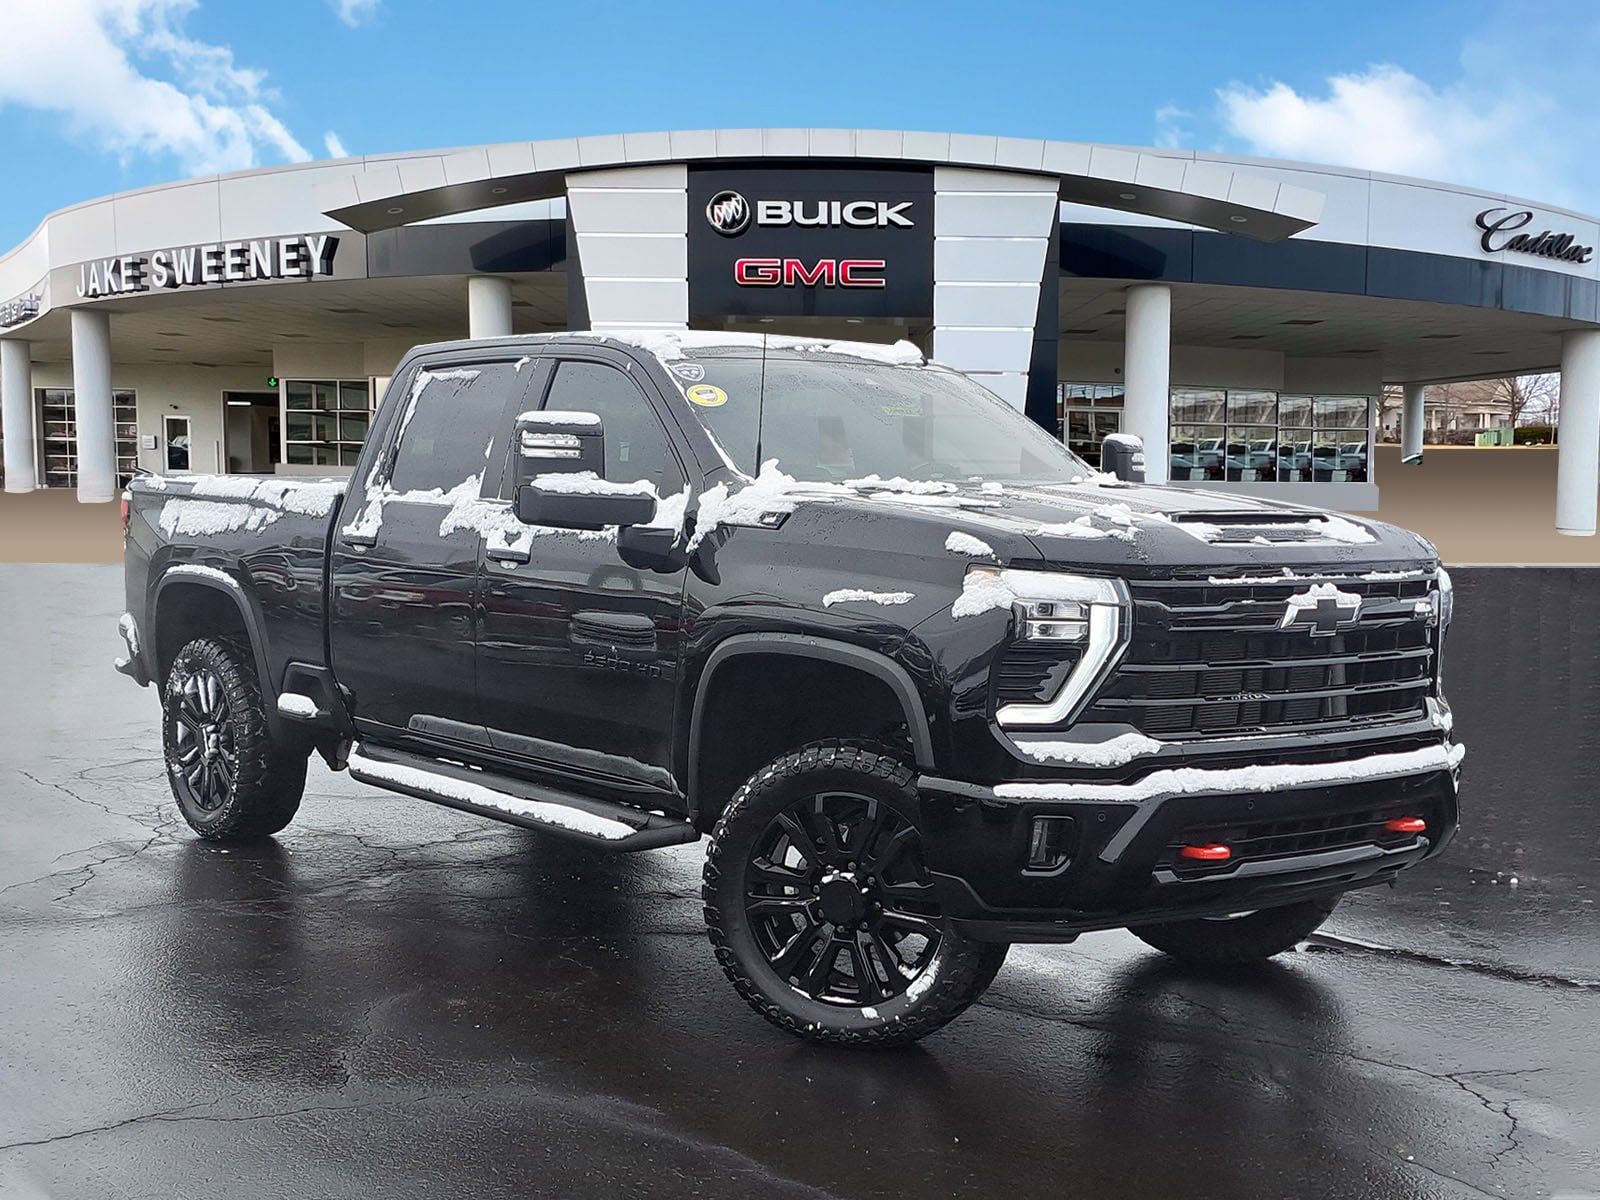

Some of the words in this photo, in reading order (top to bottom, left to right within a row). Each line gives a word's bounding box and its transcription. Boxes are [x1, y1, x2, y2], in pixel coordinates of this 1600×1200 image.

[757, 200, 915, 226] BUICK
[1475, 207, 1594, 264] Cadillac
[76, 256, 138, 297] JAKE
[152, 235, 333, 287] SWEENEY
[735, 258, 886, 287] GMC
